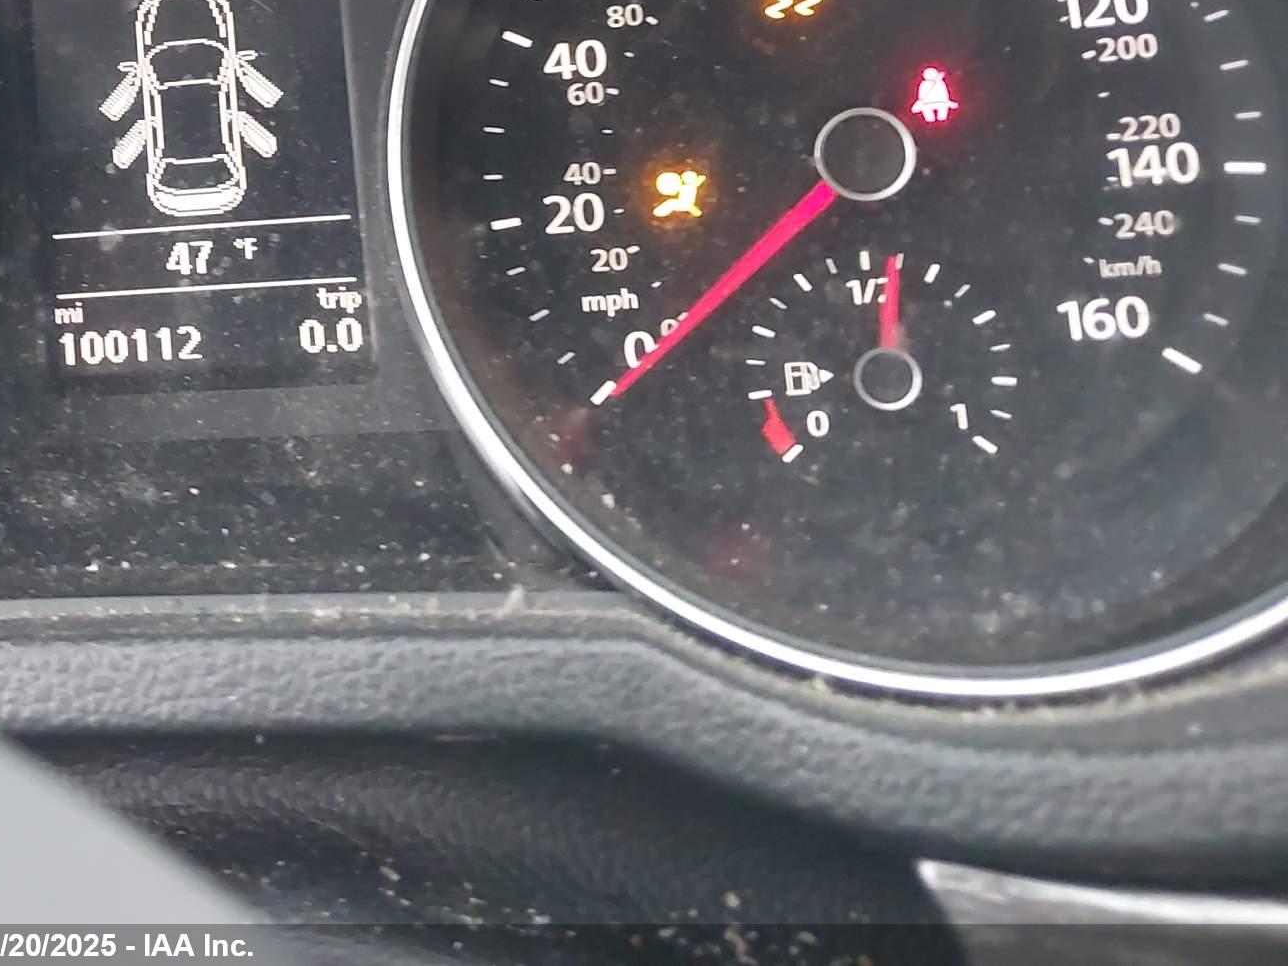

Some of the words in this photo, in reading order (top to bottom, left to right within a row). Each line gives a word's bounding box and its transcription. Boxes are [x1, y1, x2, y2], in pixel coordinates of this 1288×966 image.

[606, 3, 644, 28] 80
[543, 39, 607, 80] 40
[1096, 33, 1158, 62] 200
[567, 81, 605, 106] 60
[1118, 113, 1181, 140] 220
[563, 161, 601, 186] 40
[1106, 140, 1200, 187] 140
[542, 192, 605, 235] 20
[1114, 209, 1175, 239] 240
[165, 240, 214, 276] 47
[590, 248, 627, 272] 20
[1099, 255, 1162, 278] km/h
[54, 301, 84, 325] mi
[315, 286, 363, 314] trip
[581, 287, 639, 318] mph
[1056, 295, 1150, 342] 160
[58, 325, 203, 366] 100112
[298, 317, 364, 354] 0.0
[623, 330, 659, 369] 0
[806, 410, 830, 438] 0
[949, 403, 969, 430] 1
